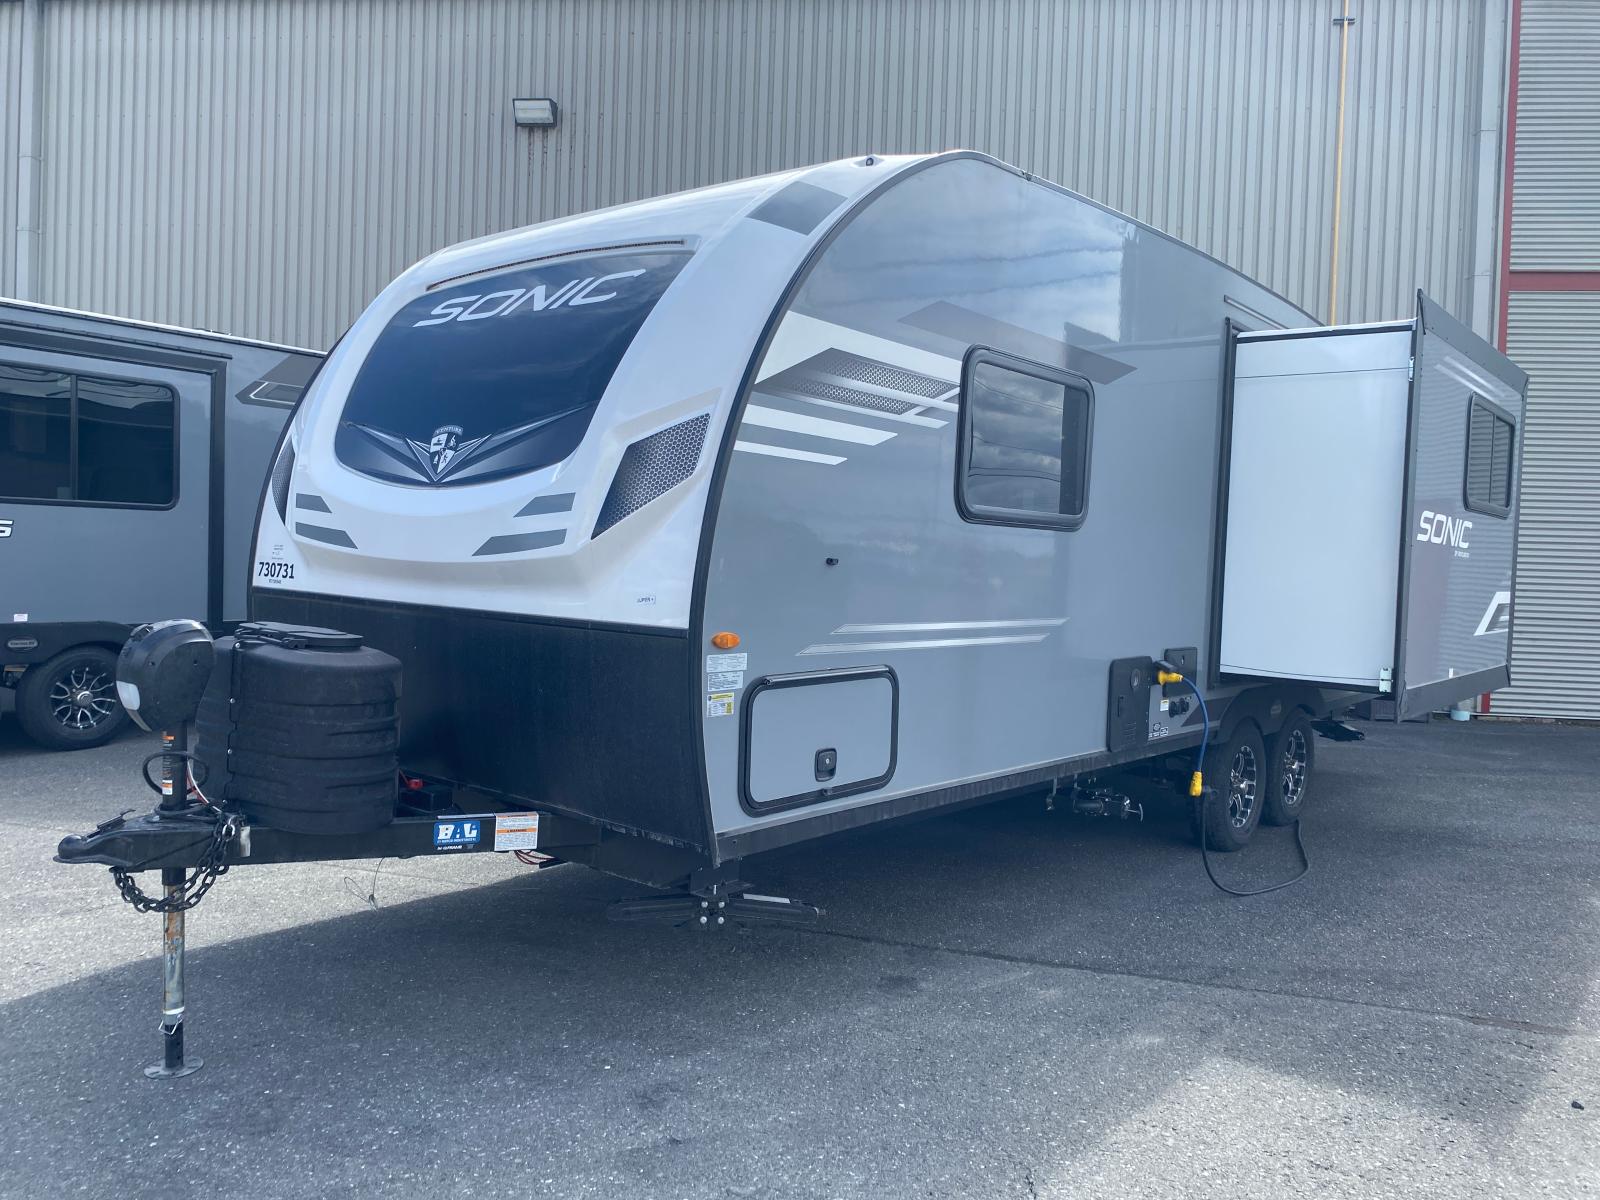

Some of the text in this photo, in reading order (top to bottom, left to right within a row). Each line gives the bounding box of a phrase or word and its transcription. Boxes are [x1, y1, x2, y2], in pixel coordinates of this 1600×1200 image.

[413, 268, 646, 328] SONIC
[1416, 510, 1473, 549] SONIC
[258, 561, 295, 579] 730731
